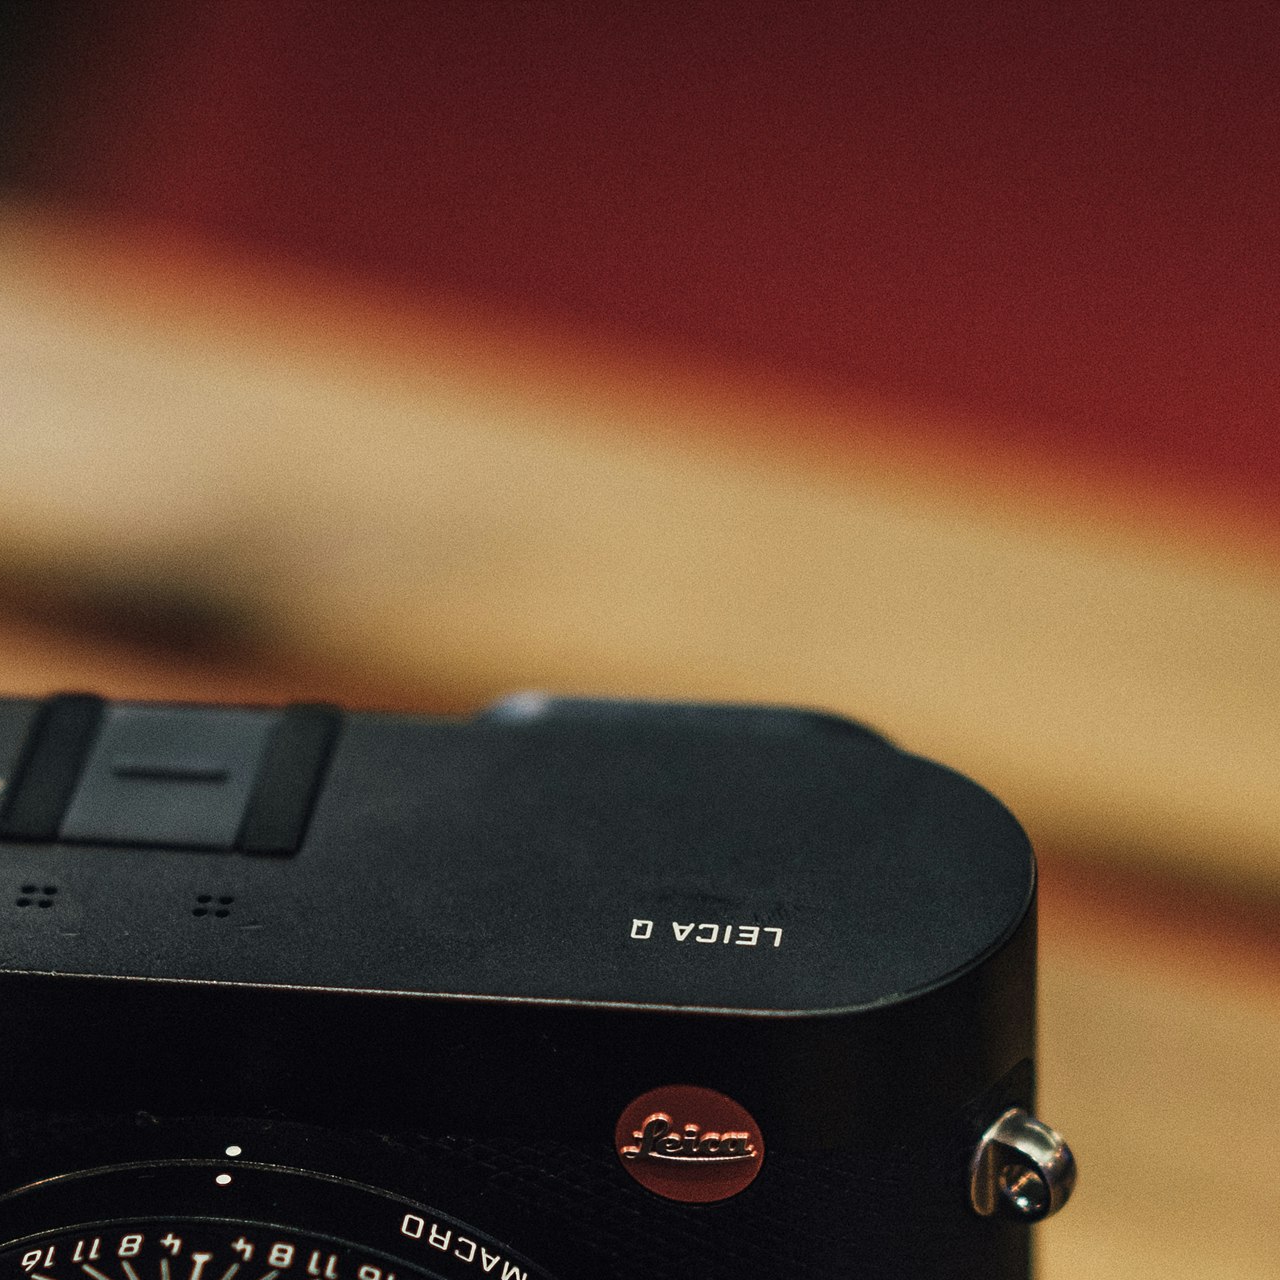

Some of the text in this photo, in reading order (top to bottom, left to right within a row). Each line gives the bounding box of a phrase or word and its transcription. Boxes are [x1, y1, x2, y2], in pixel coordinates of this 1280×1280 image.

[630, 918, 784, 948] LEICA Q
[619, 1110, 760, 1162] Leica
[71, 1237, 102, 1264] 11
[117, 1233, 145, 1258] 8
[160, 1232, 183, 1256] 4
[231, 1236, 255, 1262] 4
[266, 1242, 296, 1269] 8
[20, 1245, 56, 1273] 16
[307, 1250, 337, 1280] 11
